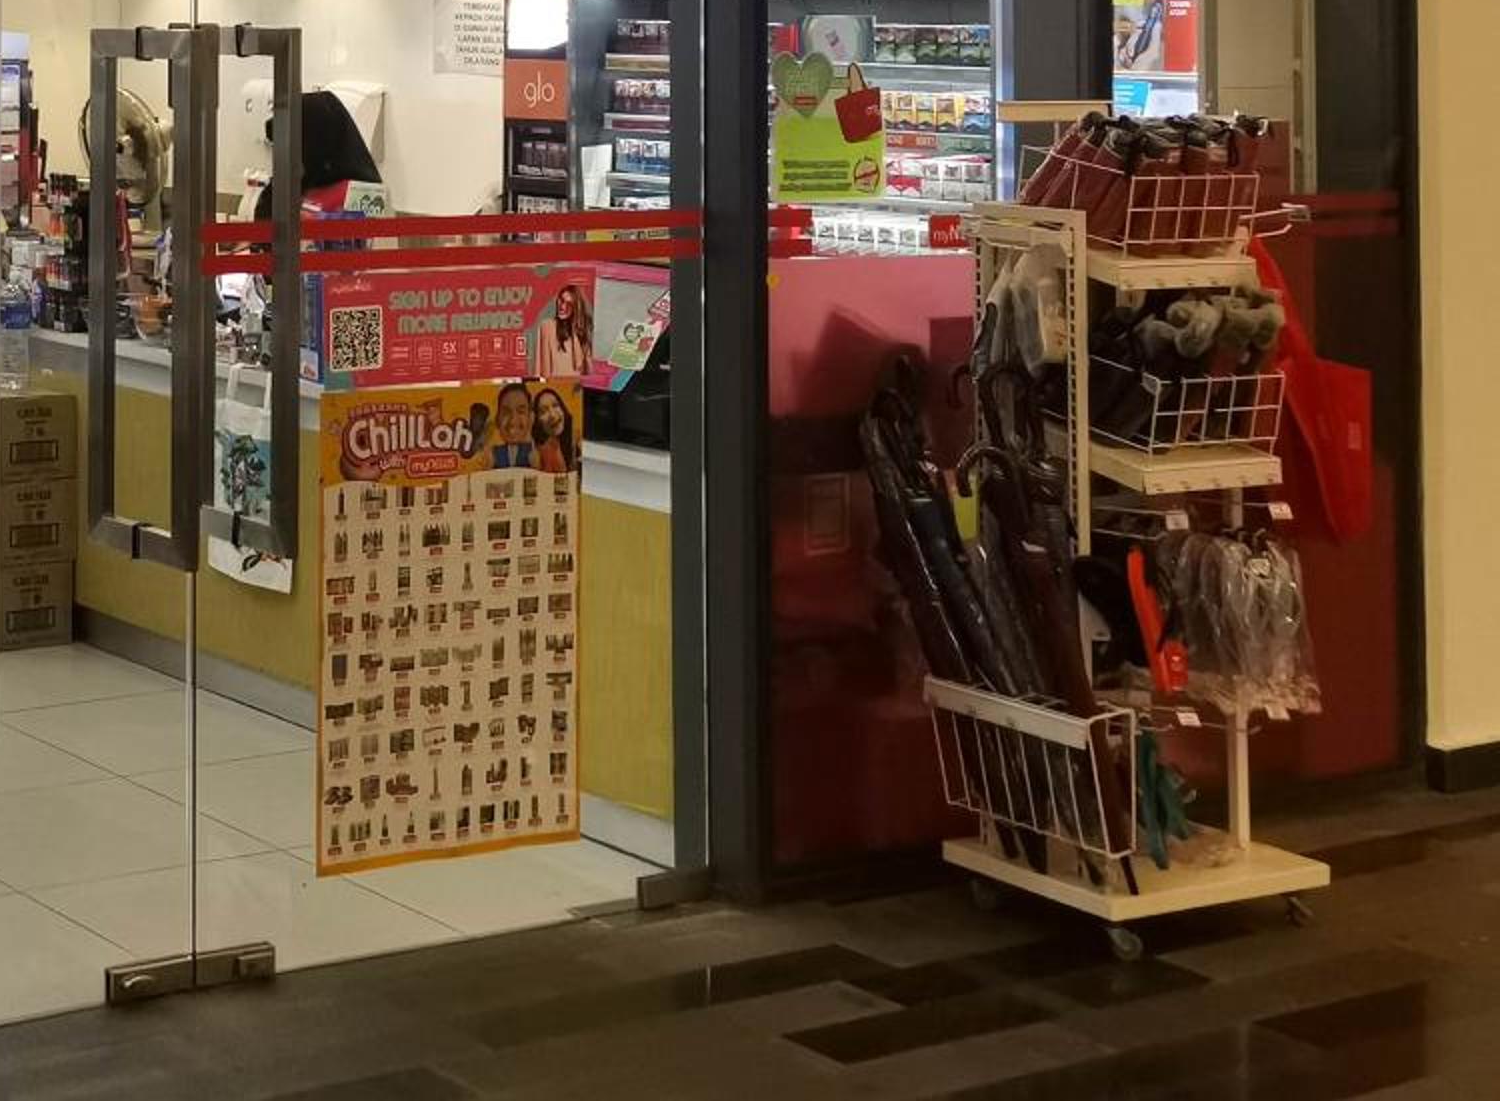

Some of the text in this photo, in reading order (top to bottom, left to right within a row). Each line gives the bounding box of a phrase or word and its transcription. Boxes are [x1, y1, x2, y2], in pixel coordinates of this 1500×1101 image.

[523, 72, 555, 108] glo
[388, 285, 533, 311] SIGN UP TO ENJOY
[397, 313, 448, 335] MORE
